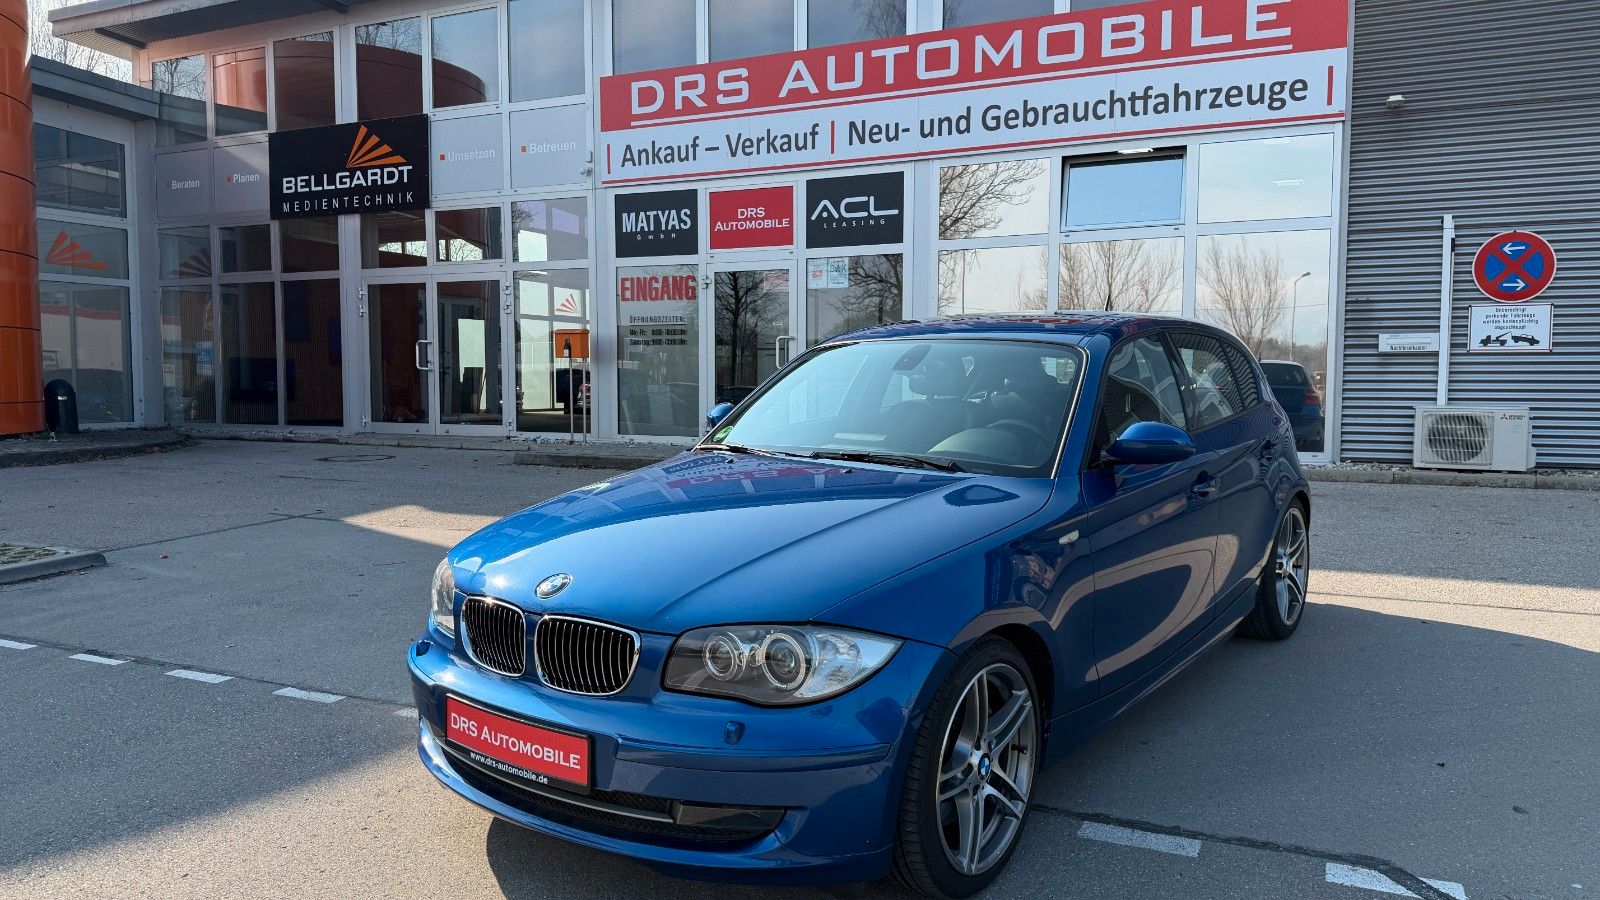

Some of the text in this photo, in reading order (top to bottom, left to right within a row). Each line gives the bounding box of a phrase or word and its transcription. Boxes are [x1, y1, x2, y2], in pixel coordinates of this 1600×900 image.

[631, 0, 1292, 115] DRS AUTOMOBILE
[621, 136, 700, 168] Ankauf
[725, 123, 820, 158] Verkauf
[848, 119, 910, 146] Neu-
[919, 106, 972, 139] und
[980, 77, 1309, 132] Gebrauchtfahrzeuge
[448, 148, 496, 162] Umsetzen
[529, 141, 577, 154] Betreuen
[171, 180, 200, 190] Beraten
[233, 173, 260, 184] Planen
[282, 165, 413, 194] BELLGARDT
[283, 191, 413, 213] MEDIENTECHNIK
[737, 207, 766, 219] DRS
[810, 195, 899, 221] ACL
[622, 208, 692, 233] MATYAS
[714, 218, 791, 232] AUTOMOBILE
[823, 218, 886, 229] LEASING
[620, 274, 697, 302] EINGANG
[450, 712, 581, 770] DRS AUTOMOBILE
[470, 751, 548, 785] www.drs-automobile.de
